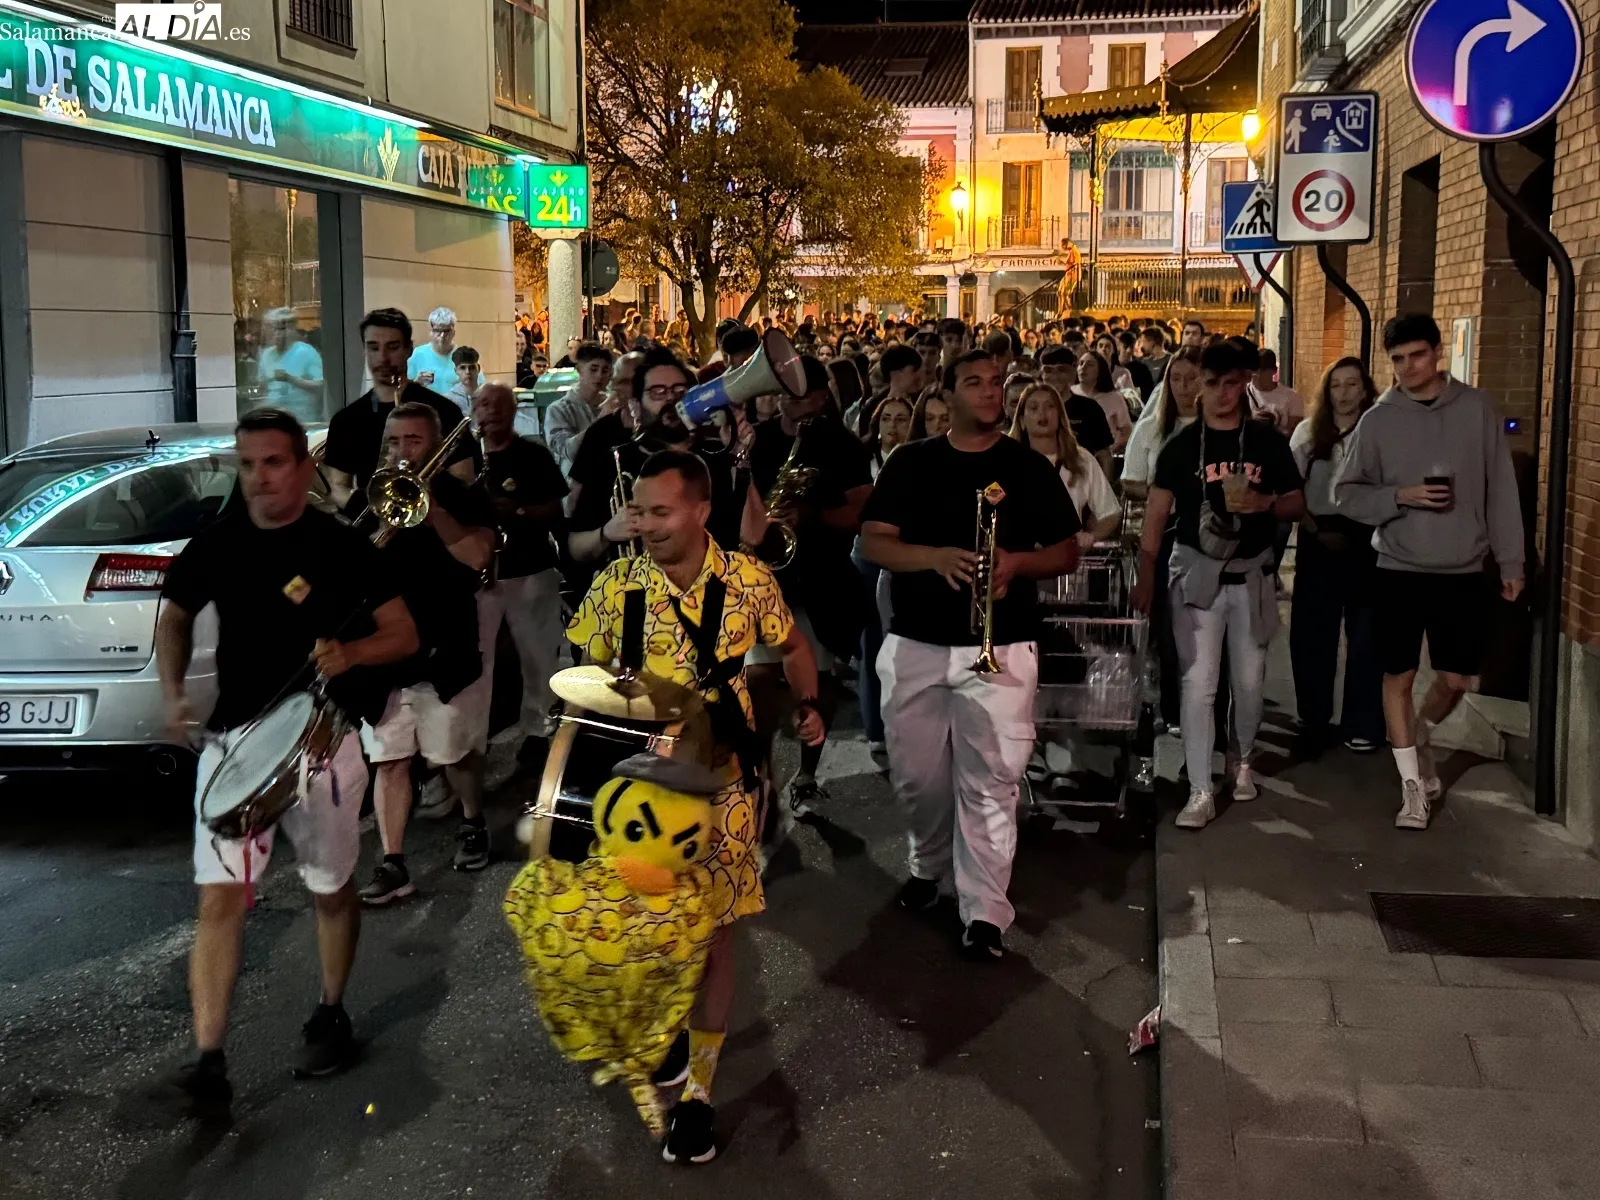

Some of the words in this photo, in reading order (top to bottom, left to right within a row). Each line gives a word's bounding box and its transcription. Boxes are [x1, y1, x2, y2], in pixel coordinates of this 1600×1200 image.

[24, 37, 78, 101] DE
[88, 55, 276, 148] SALAMANCA
[418, 145, 455, 189] CAJA
[536, 195, 582, 226] 24h
[1304, 189, 1344, 213] 20
[21, 700, 70, 724] GJJ
